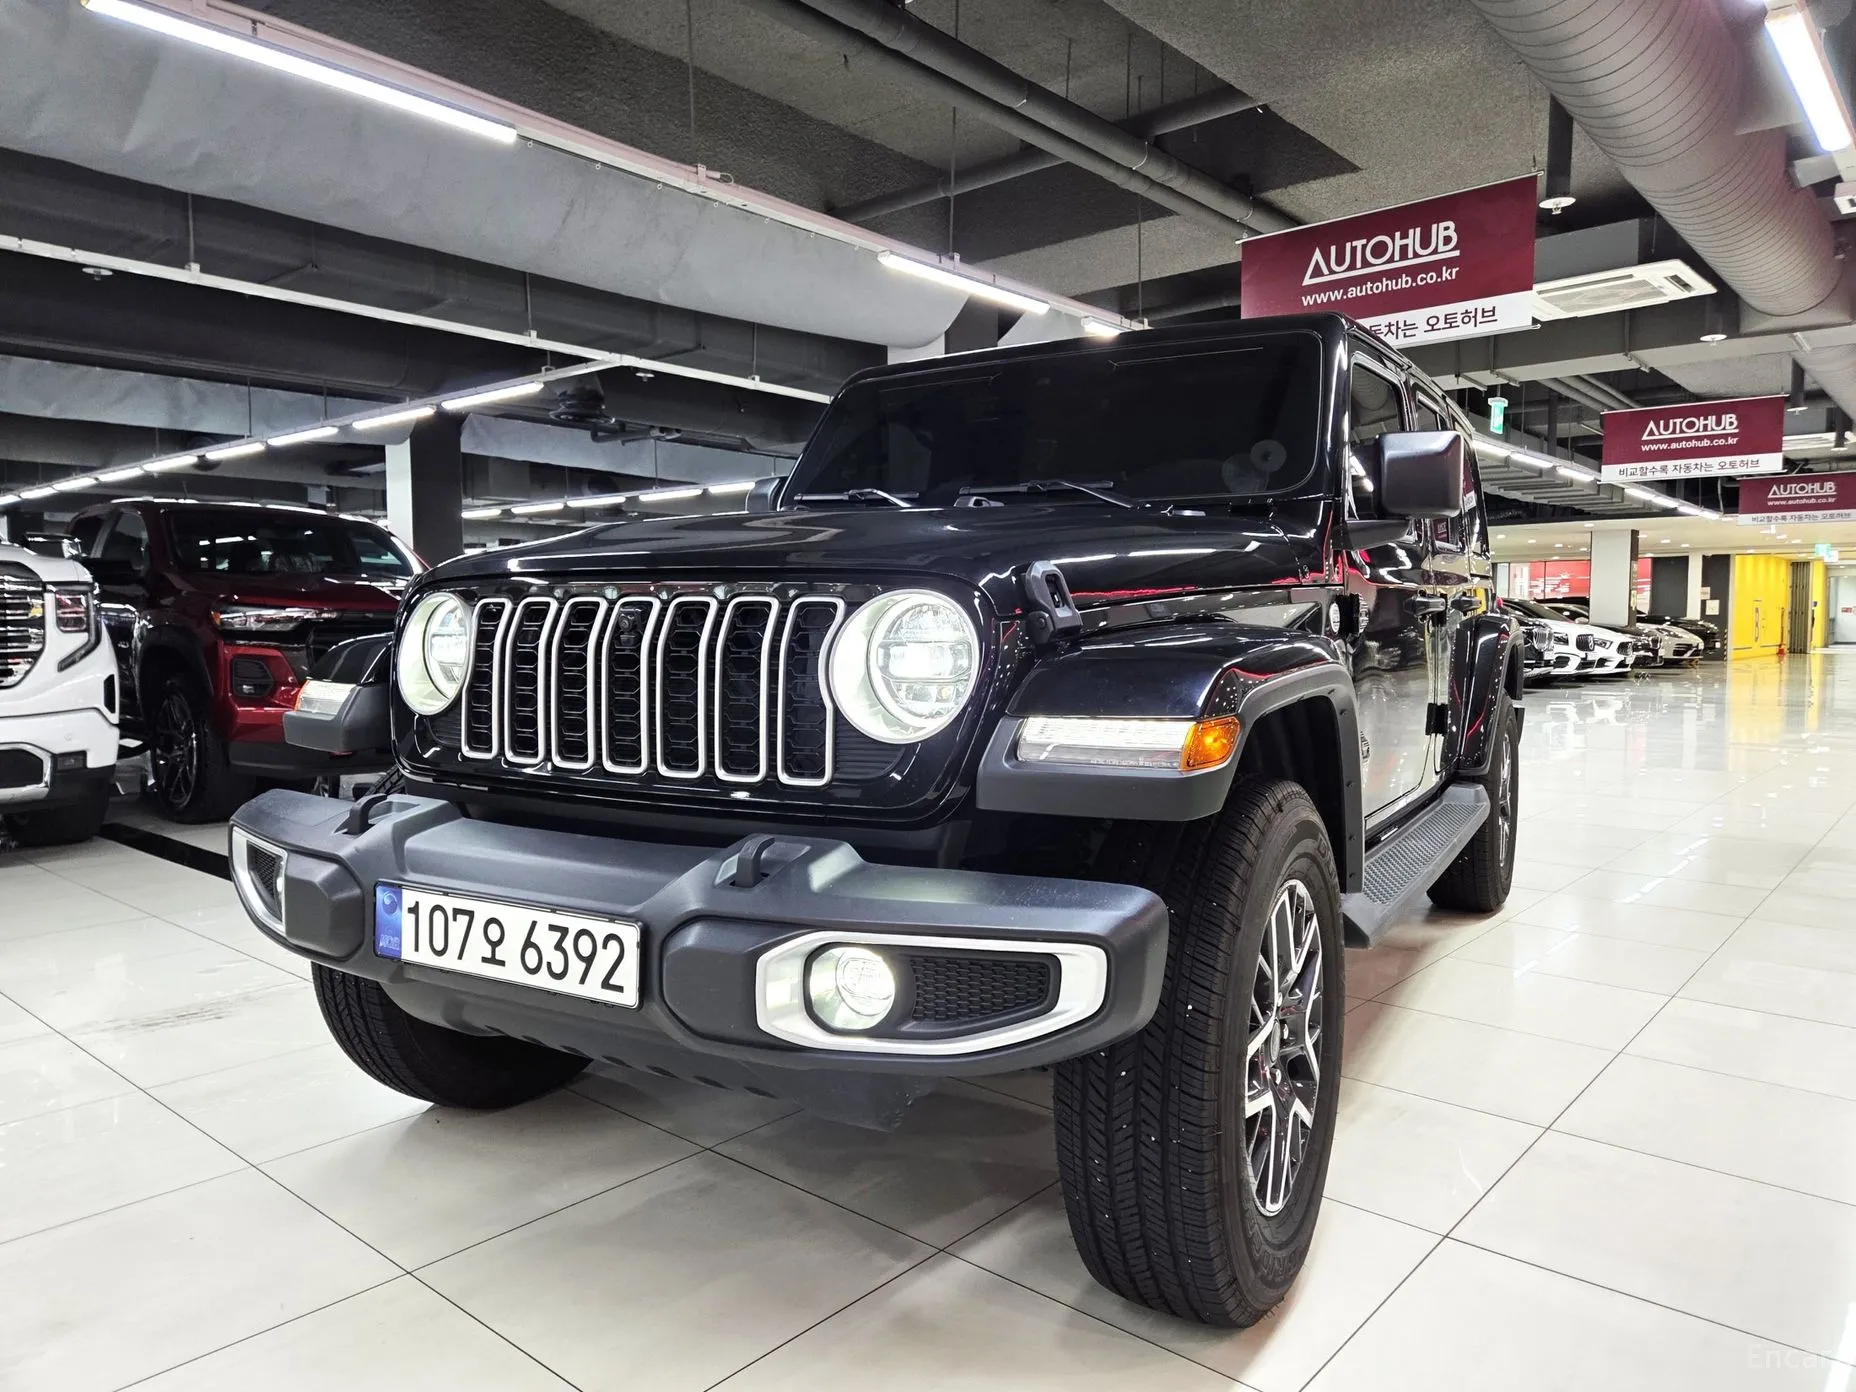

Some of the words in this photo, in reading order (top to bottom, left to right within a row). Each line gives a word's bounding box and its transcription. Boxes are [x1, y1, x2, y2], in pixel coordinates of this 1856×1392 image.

[1302, 220, 1460, 286] AUTOHUB
[1301, 265, 1460, 306] www.autohub.co.kr
[1423, 306, 1498, 333] 오토허브
[1641, 413, 1739, 441] AUTOHUB
[1641, 436, 1739, 452] www.autohub.co.kr
[1619, 465, 1669, 477] 비교할수록
[1672, 462, 1714, 474] 자동차는
[1717, 459, 1761, 470] 오토허브
[1767, 481, 1837, 498] AUTOHUB
[1767, 497, 1837, 506] www.autohub.co.kr
[520, 920, 625, 994] 6392
